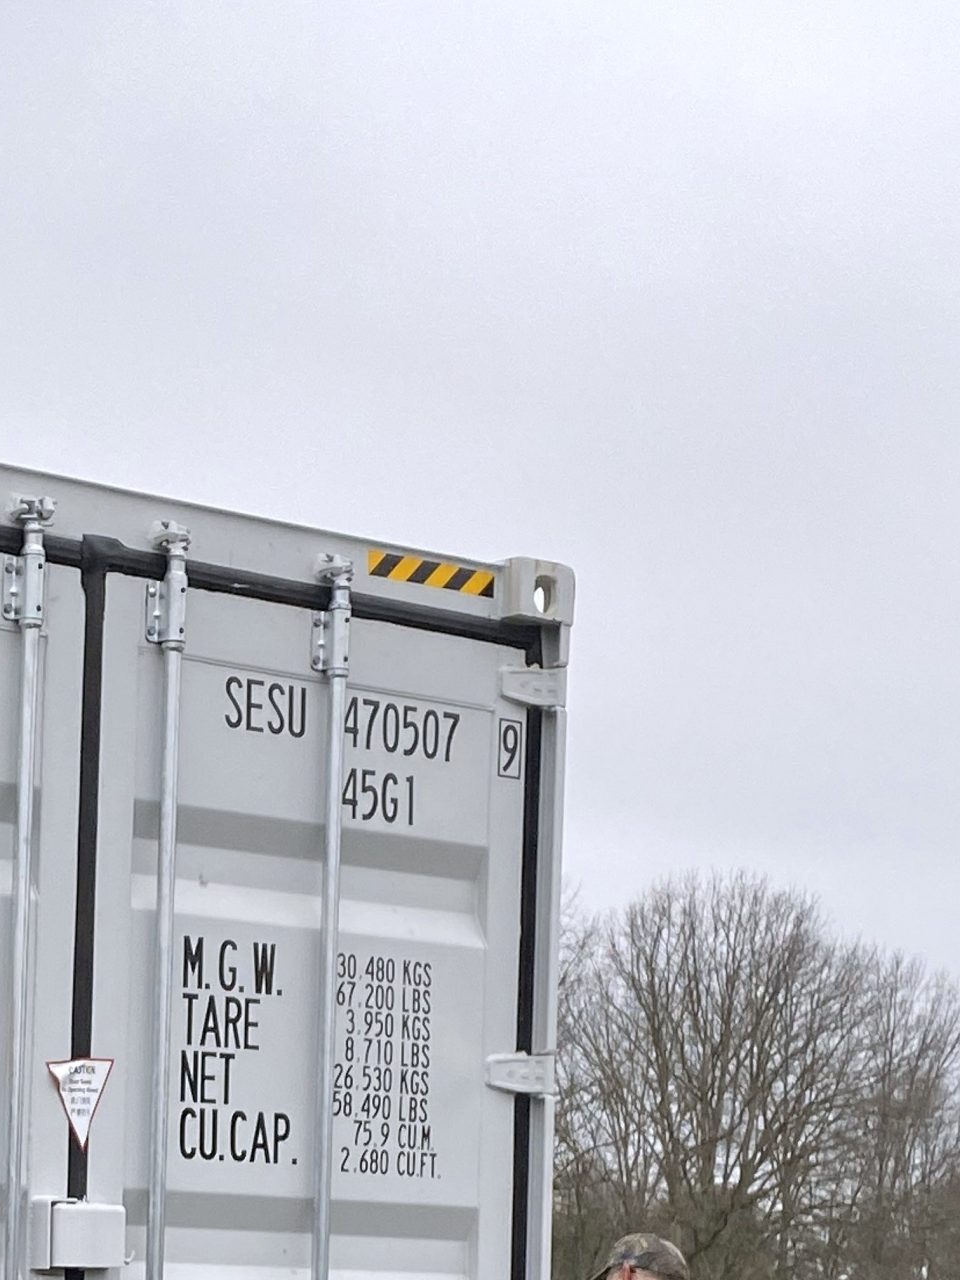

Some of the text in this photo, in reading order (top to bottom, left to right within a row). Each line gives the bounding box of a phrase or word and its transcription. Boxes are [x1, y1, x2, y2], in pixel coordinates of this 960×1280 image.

[224, 676, 519, 772] SESU 470507 9
[342, 768, 414, 826] 45G1
[403, 960, 432, 988] KGS
[402, 987, 431, 1015] LBS
[182, 993, 261, 1050] TARE
[402, 1014, 431, 1042] KGS
[401, 1041, 430, 1069] LBS
[180, 1050, 236, 1105] NET
[400, 1069, 429, 1096] KGS
[399, 1096, 427, 1123] LBS
[353, 1120, 390, 1148] 75.9
